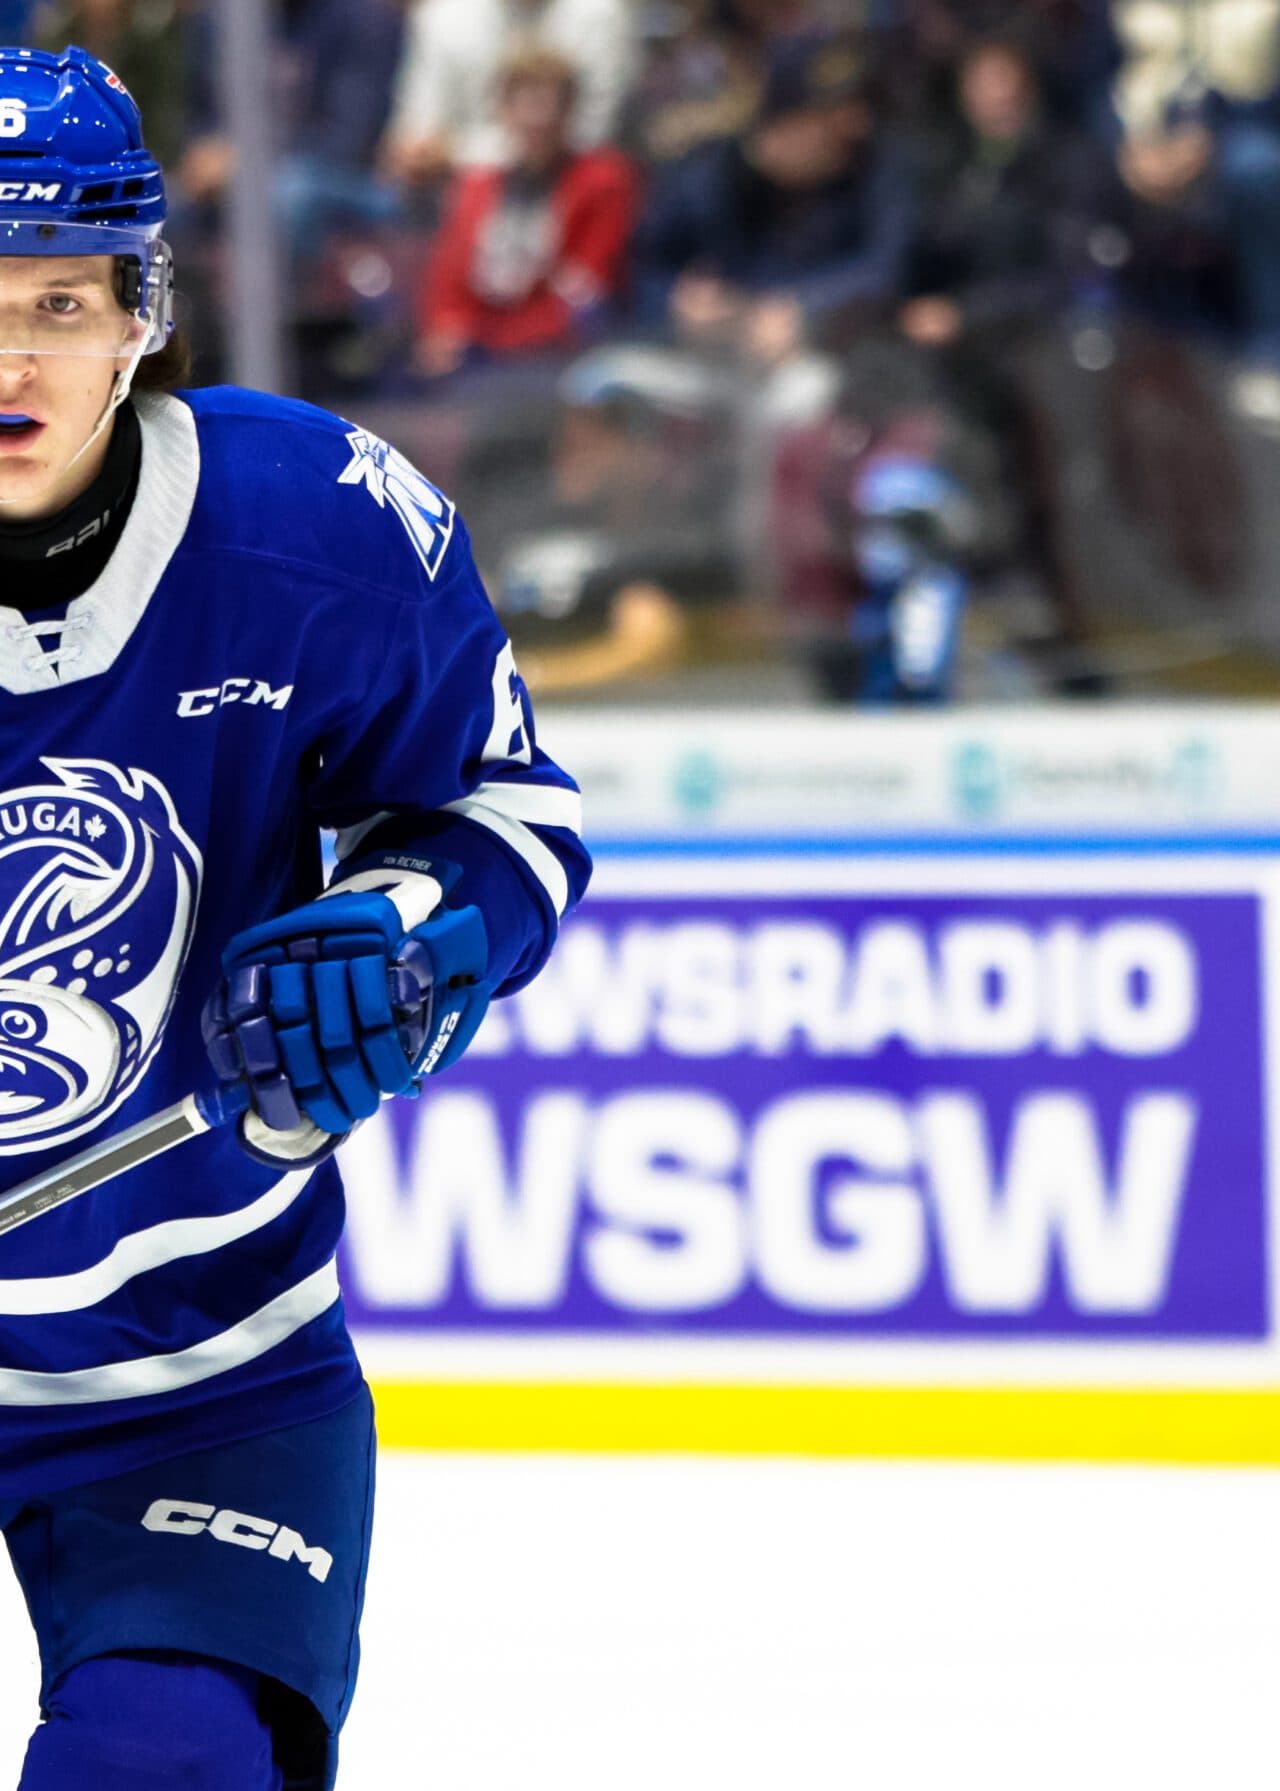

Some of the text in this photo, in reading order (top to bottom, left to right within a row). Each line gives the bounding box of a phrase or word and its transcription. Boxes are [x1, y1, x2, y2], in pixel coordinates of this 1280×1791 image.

[176, 678, 294, 718] CCM
[465, 916, 1198, 1058] WSRADIO
[334, 1088, 1198, 1316] WSGW
[141, 1499, 333, 1583] CCM
